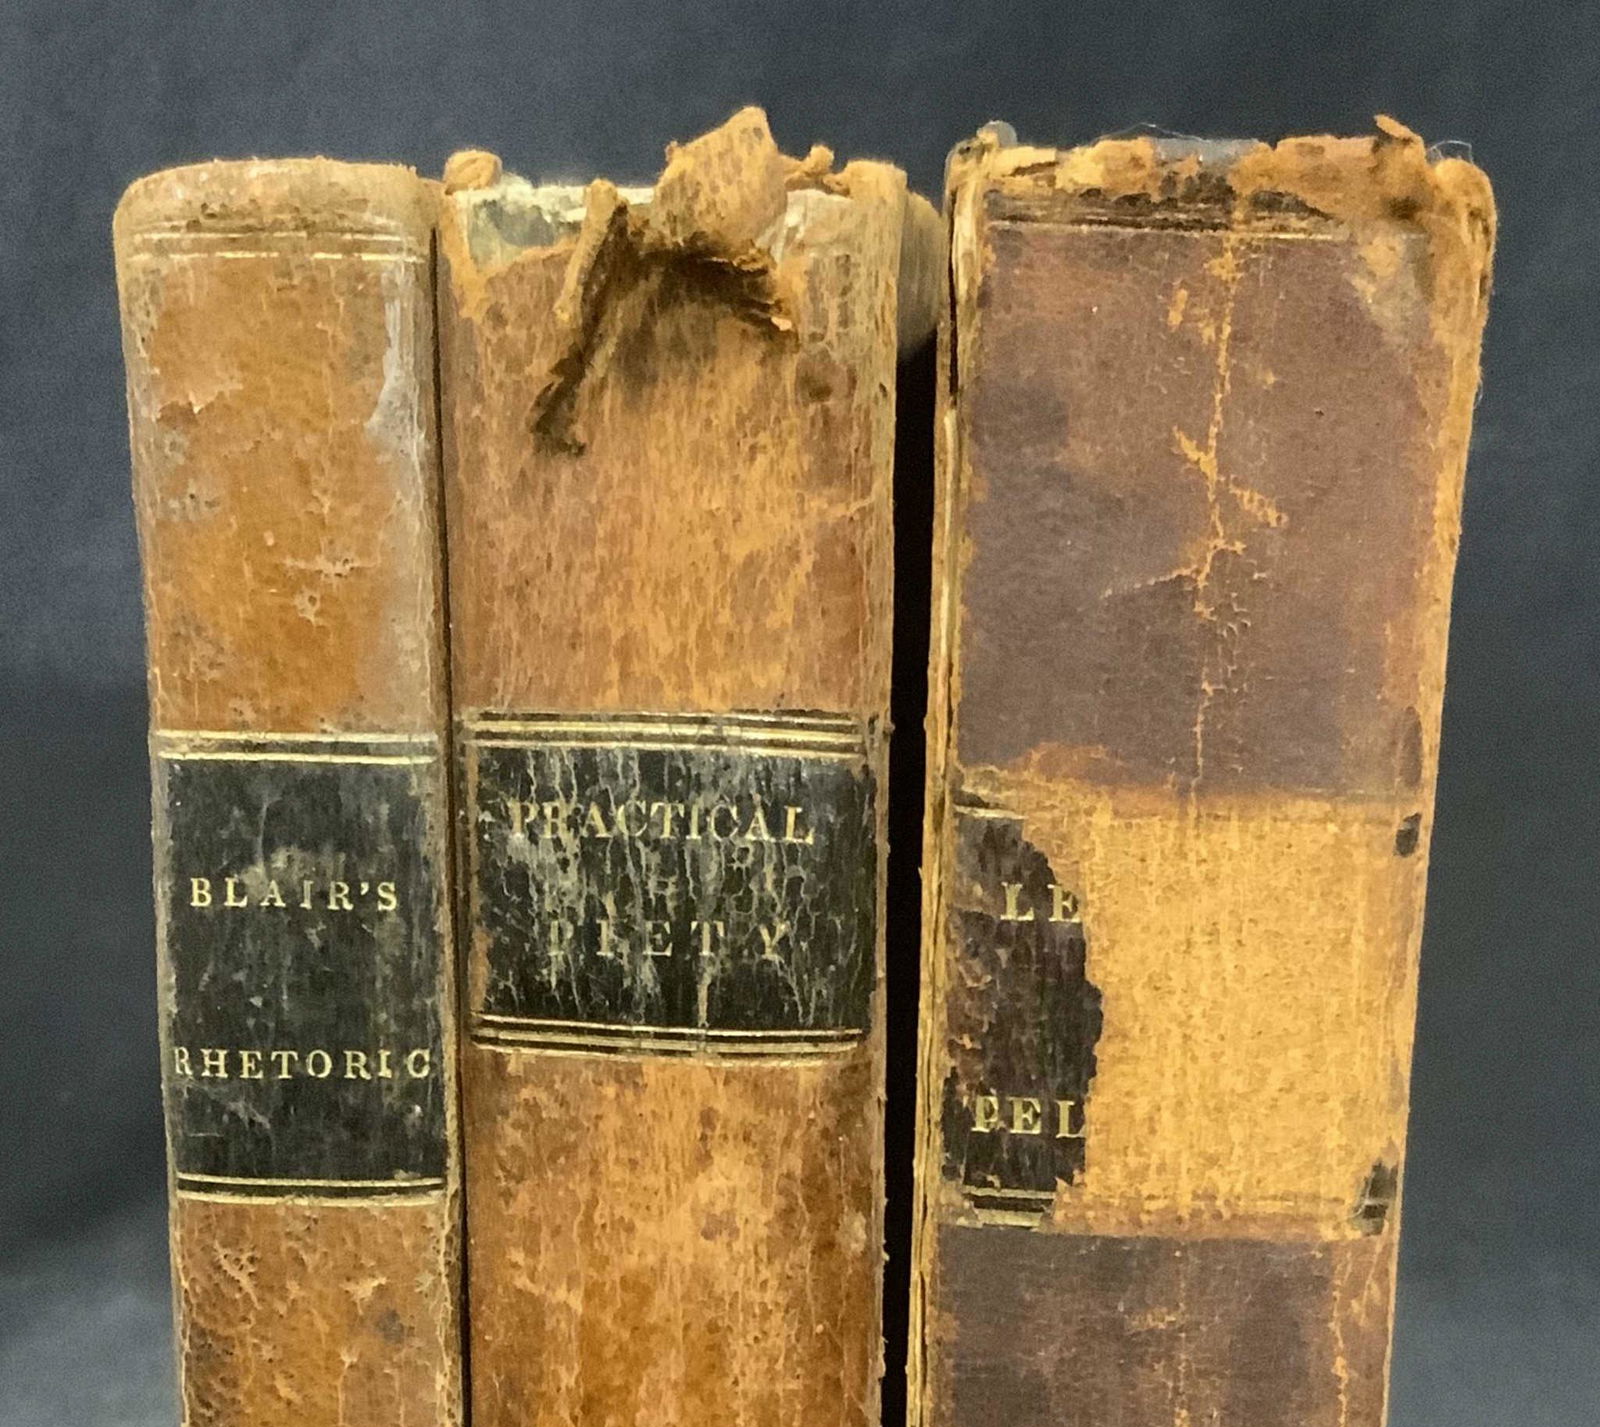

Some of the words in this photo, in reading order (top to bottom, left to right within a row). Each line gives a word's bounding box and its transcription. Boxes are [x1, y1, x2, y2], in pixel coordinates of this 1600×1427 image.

[509, 801, 814, 845] PRACTICAL
[190, 877, 398, 911] BLAIR'S
[547, 919, 791, 958] PIETY
[173, 1047, 431, 1079] RHETORIC
